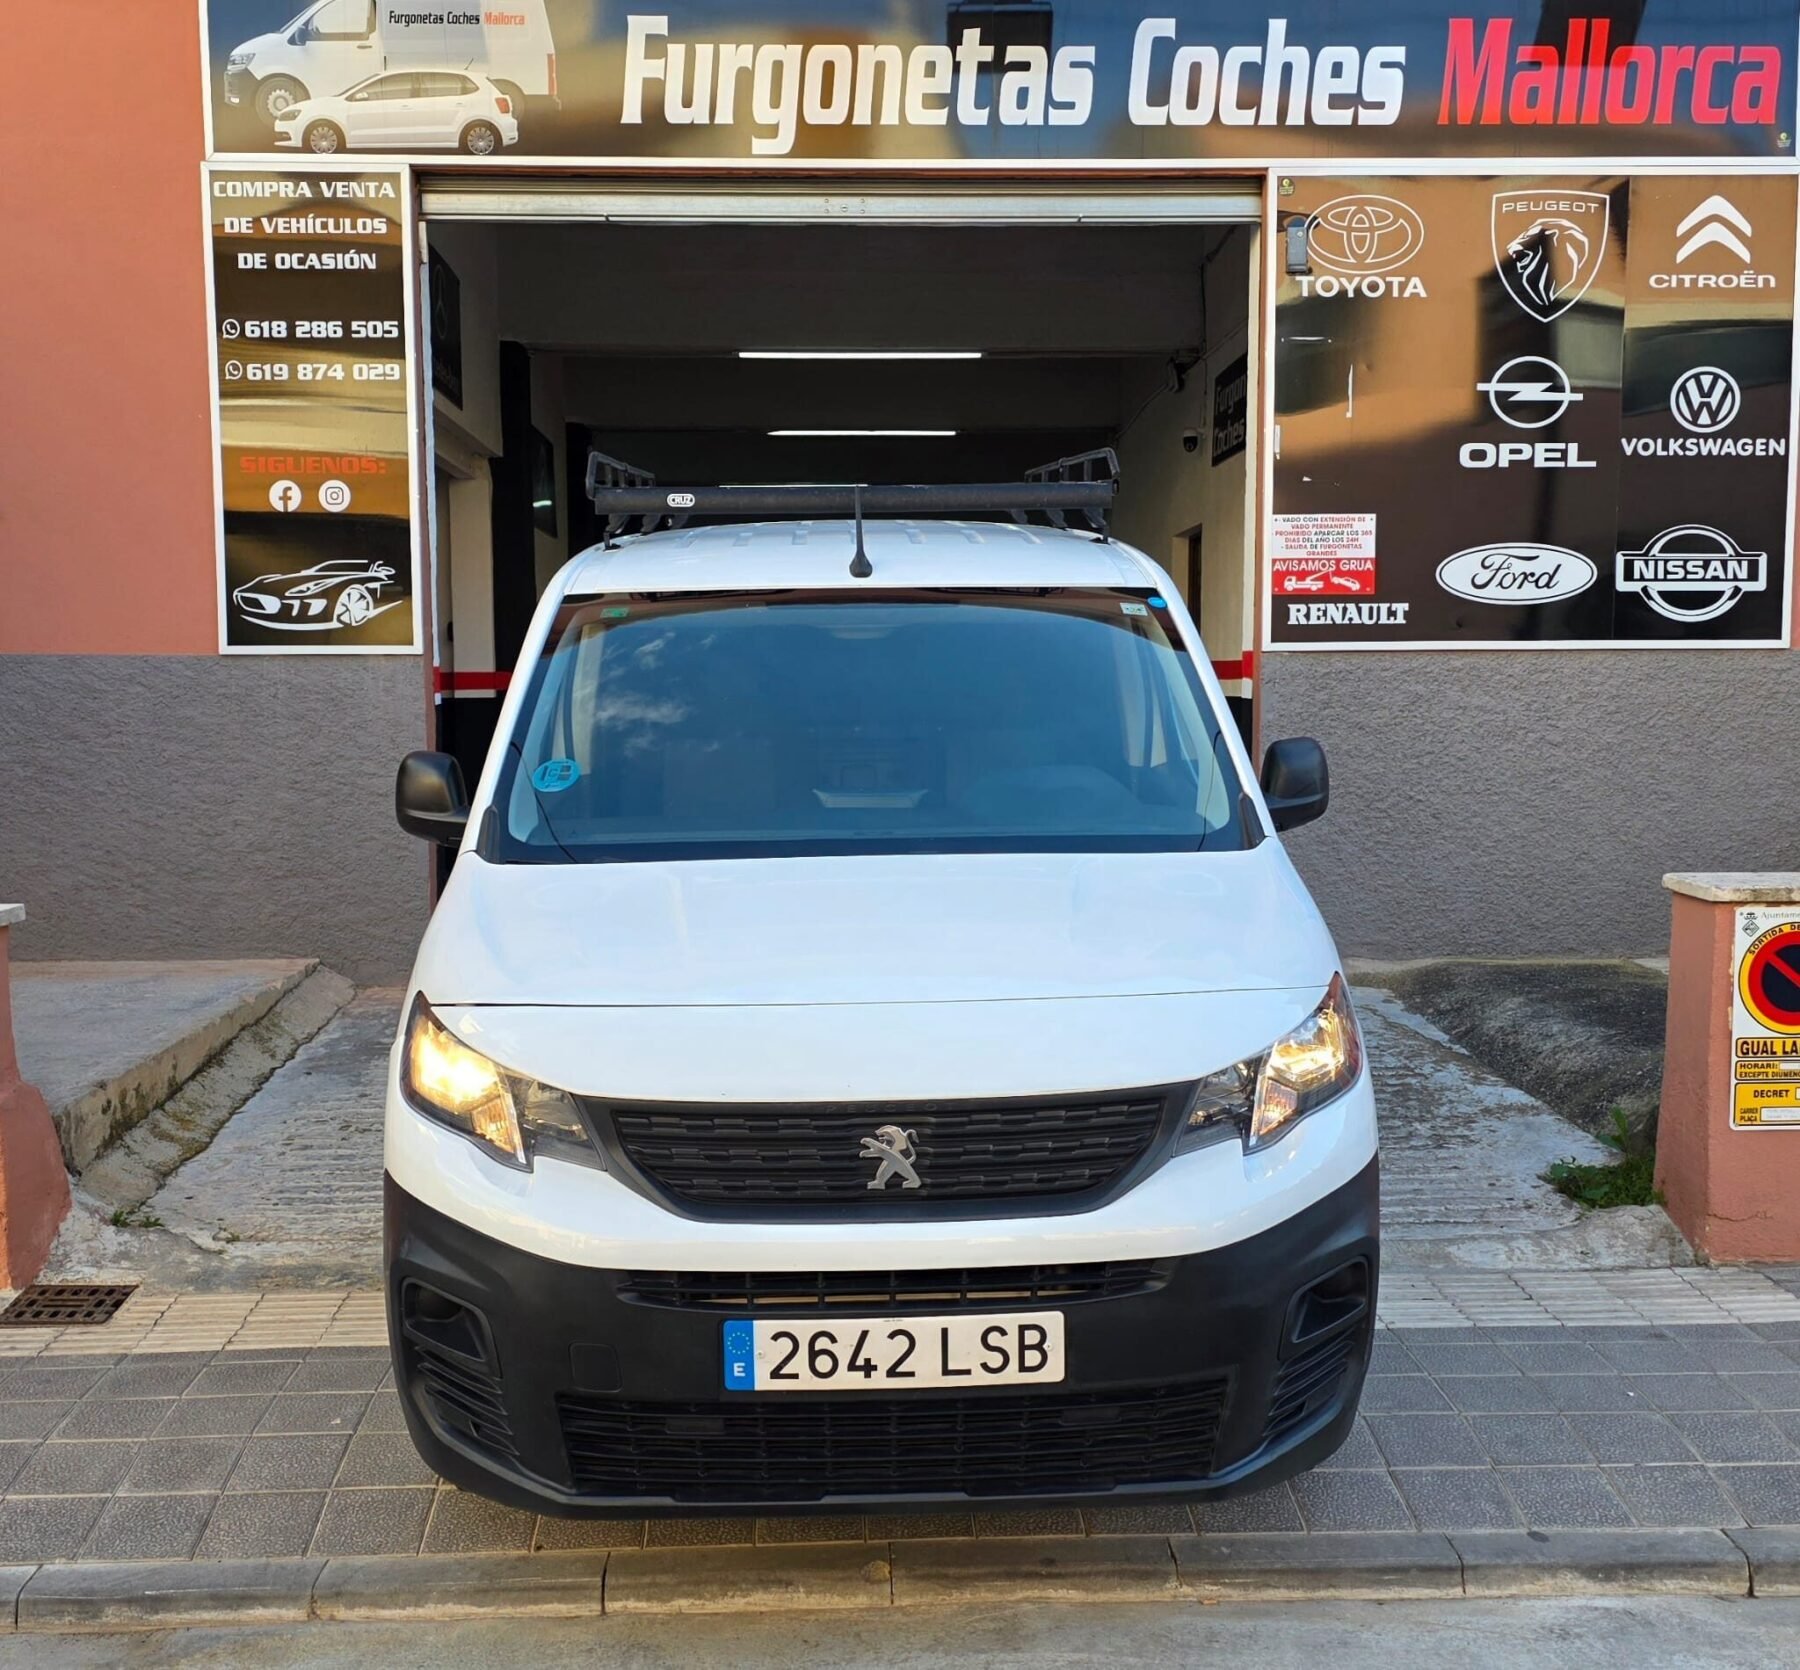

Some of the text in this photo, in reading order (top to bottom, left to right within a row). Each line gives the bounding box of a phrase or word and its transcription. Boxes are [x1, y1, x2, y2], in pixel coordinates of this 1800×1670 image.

[389, 10, 525, 28] Furgonetas Coches Mallorca
[620, 14, 1783, 155] Furgonetas Coches Mallorca
[213, 181, 396, 198] COMPRA VENTA
[1502, 200, 1600, 214] PEUGEOT
[223, 213, 388, 234] DE VEHÍCULOS
[237, 249, 377, 270] DE OCASIÓN
[1295, 275, 1428, 298] TOYOTA
[244, 321, 399, 338] 618 286 505
[246, 363, 401, 381] 619 874 029
[1459, 442, 1597, 468] OPEL
[1621, 438, 1786, 456] VOLKSWAGEN
[239, 456, 387, 474] SIGUENOS:
[670, 495, 693, 505] CRUZ
[1273, 560, 1374, 571] AVISAMOS GRUA
[1470, 553, 1562, 590] Ford
[1633, 560, 1748, 579] NISSAN
[1287, 603, 1409, 625] RENAULT
[1748, 927, 1784, 956] SORTIDA
[1740, 1040, 1777, 1056] GUAL
[1753, 1089, 1790, 1098] DECRET
[769, 1324, 1049, 1380] 2642 LSB
[734, 1363, 745, 1376] E
